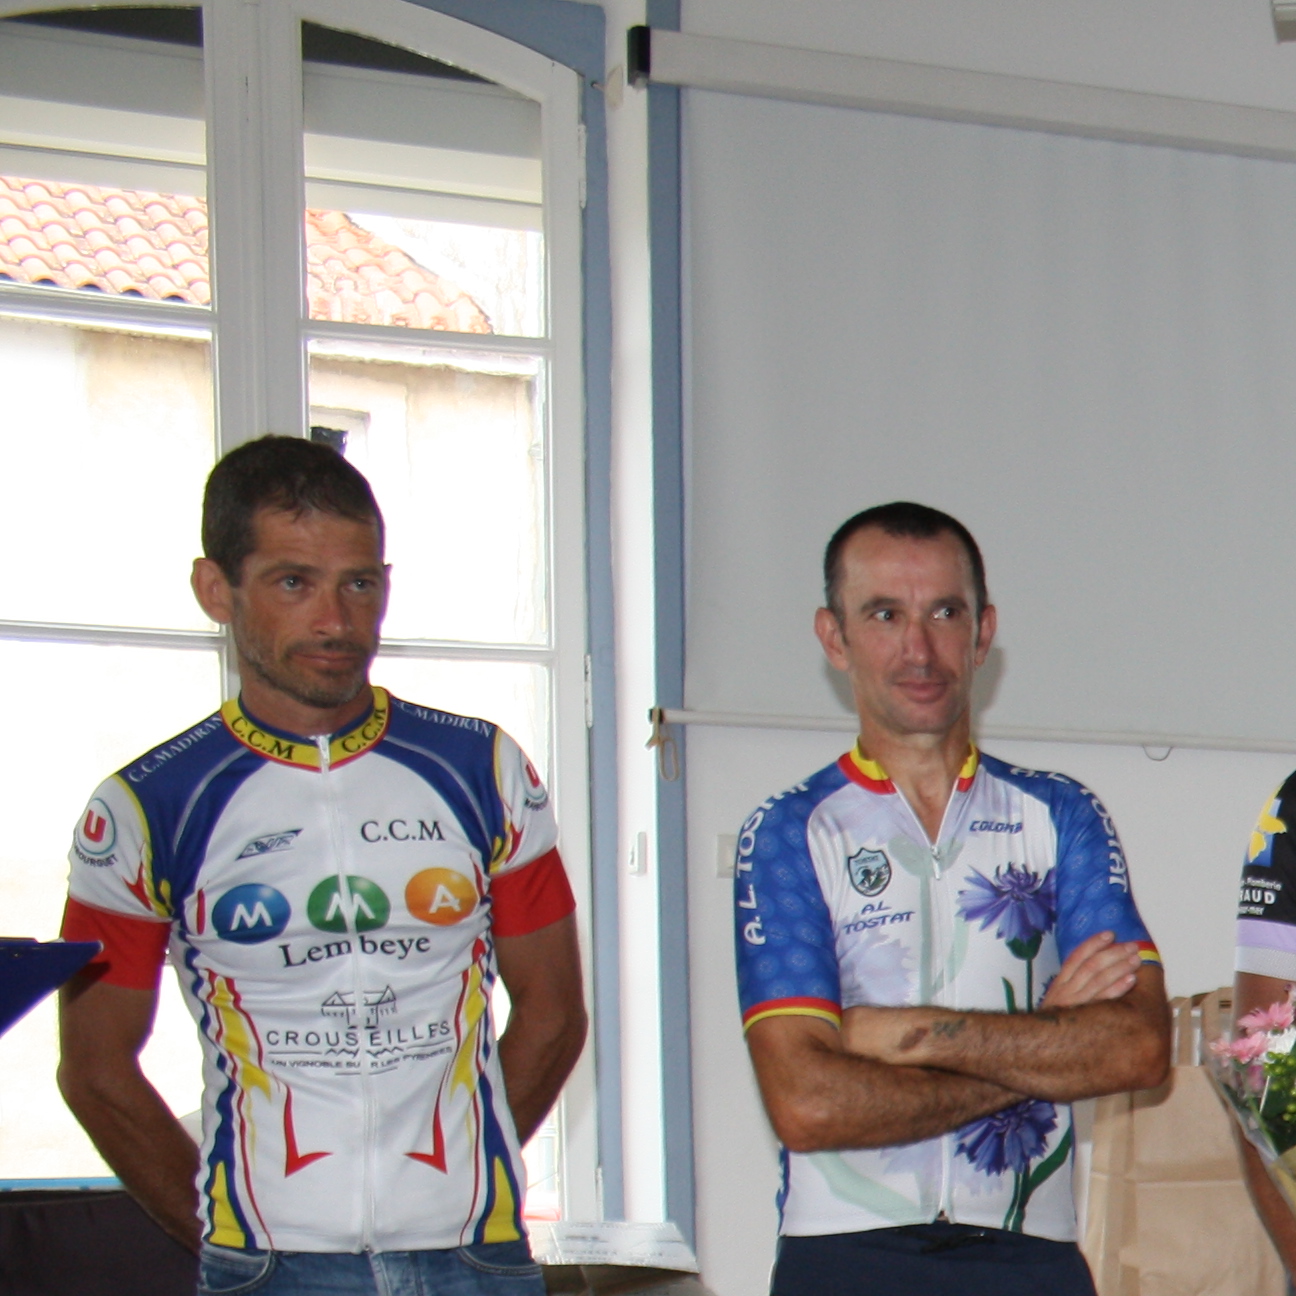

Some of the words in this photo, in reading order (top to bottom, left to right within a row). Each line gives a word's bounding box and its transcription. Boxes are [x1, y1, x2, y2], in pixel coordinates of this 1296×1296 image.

[360, 819, 446, 843] C.C.M
[230, 901, 273, 931] M
[429, 883, 462, 914] A
[843, 910, 916, 935] TOSTAT
[279, 934, 431, 968] Lembeye
[266, 1020, 451, 1047] CROUSEILLES
